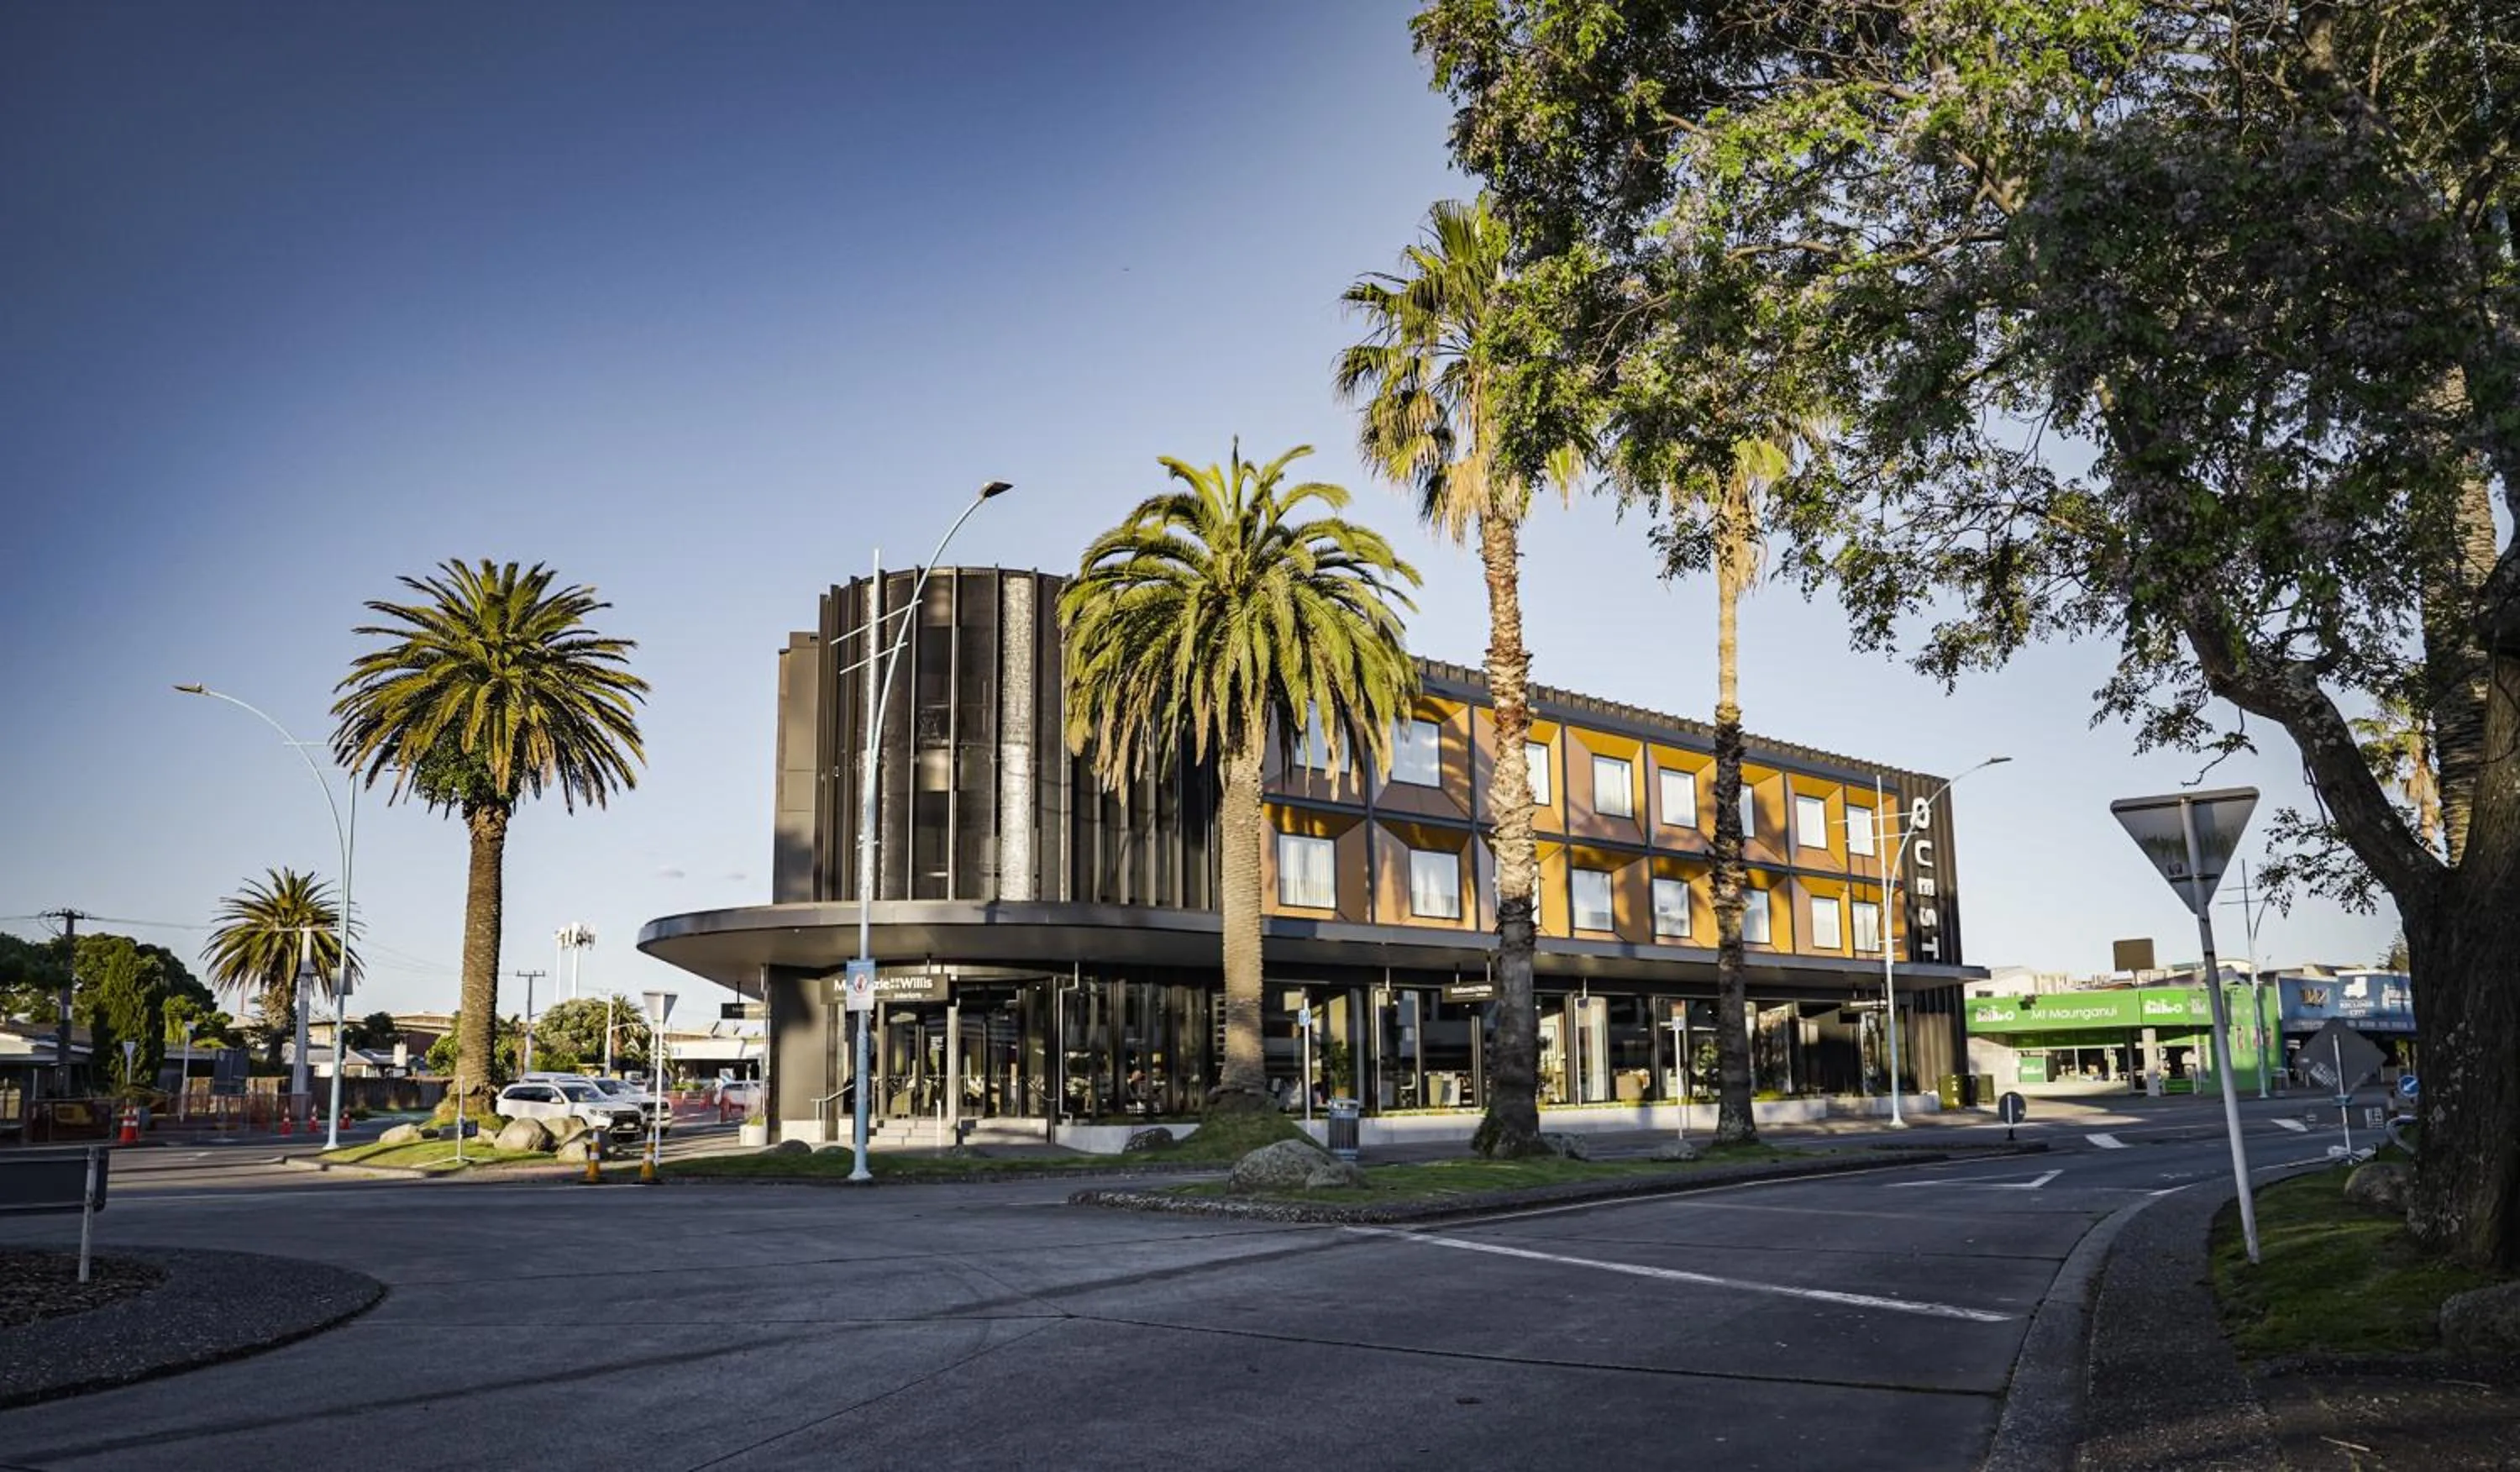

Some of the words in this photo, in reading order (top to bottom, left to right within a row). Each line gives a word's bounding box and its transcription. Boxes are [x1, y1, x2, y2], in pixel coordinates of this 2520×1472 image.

[1909, 796, 1940, 959] QUEST
[900, 977, 933, 989] Willis
[2049, 1007, 2118, 1021] Maunganui
